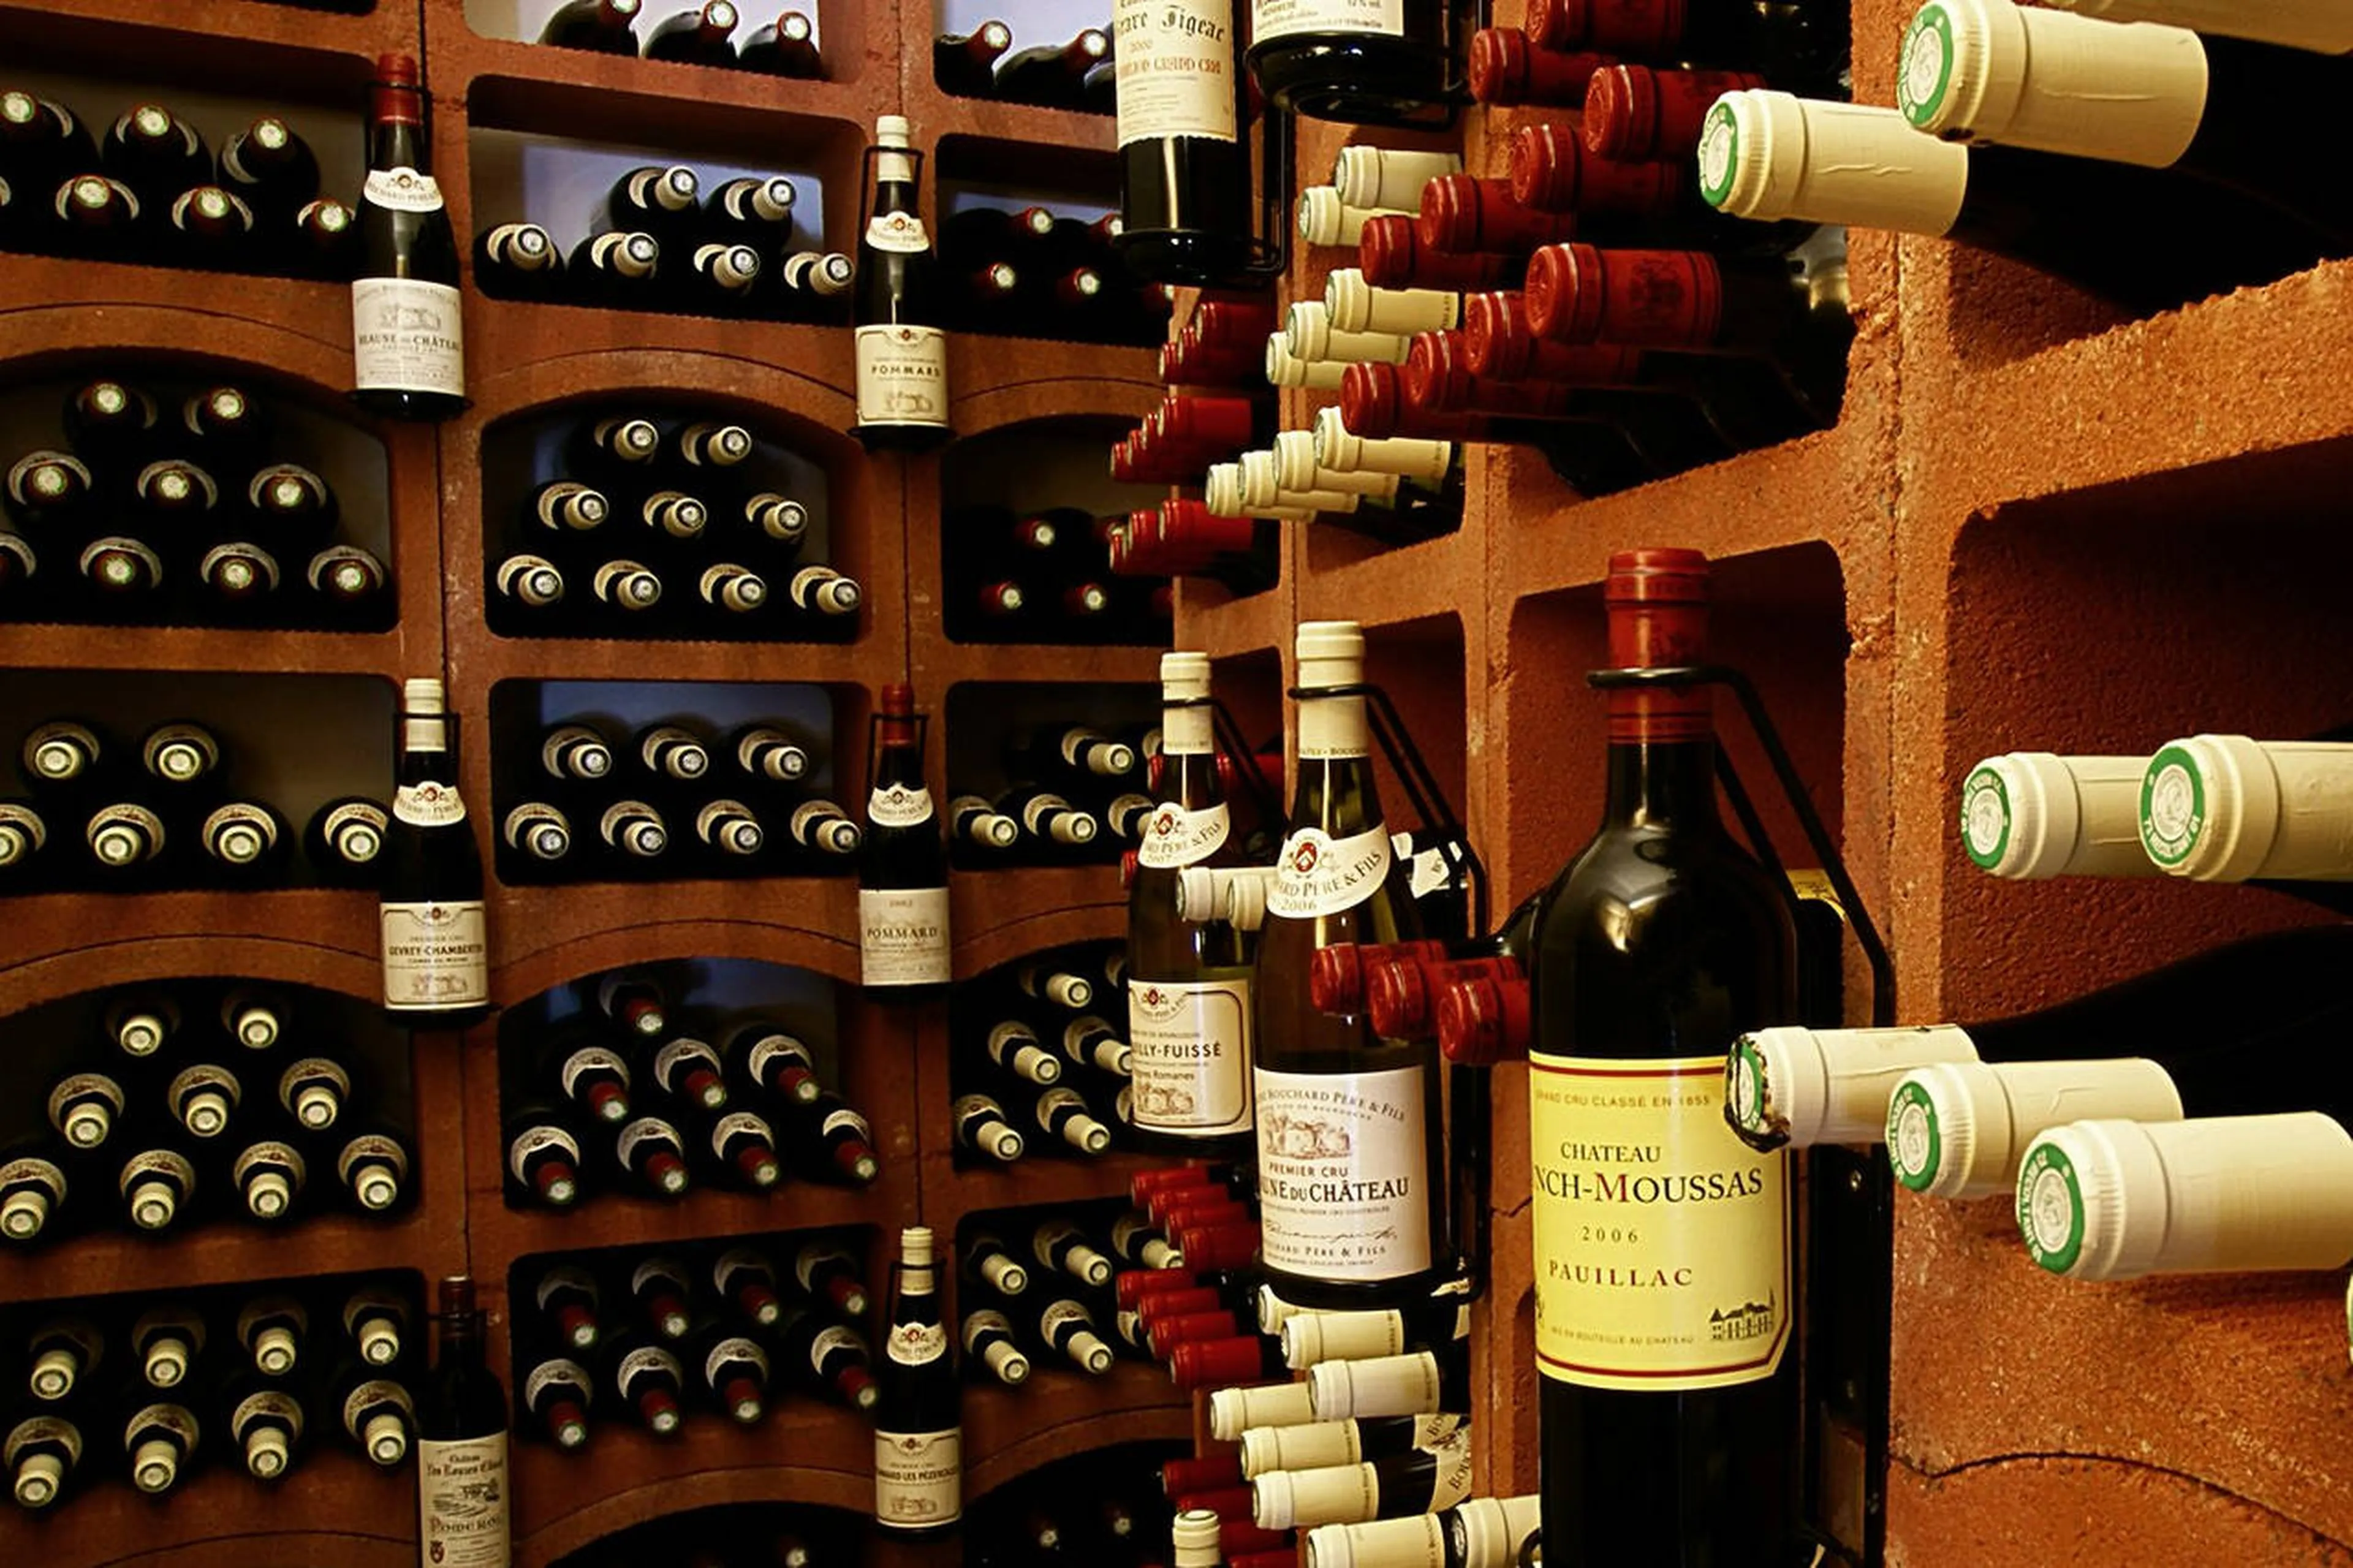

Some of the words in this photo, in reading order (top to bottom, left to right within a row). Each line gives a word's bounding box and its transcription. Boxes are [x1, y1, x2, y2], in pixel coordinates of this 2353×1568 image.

[1344, 873, 1357, 886] &
[1355, 852, 1382, 877] FILS
[1651, 1095, 1672, 1108] EN
[1269, 1161, 1315, 1177] PREMIER
[1320, 1165, 1349, 1178] CRU
[1309, 1176, 1410, 1203] CHÂTEAU
[1582, 1225, 1638, 1243] 2006
[1549, 1259, 1693, 1287] PAUILLAC
